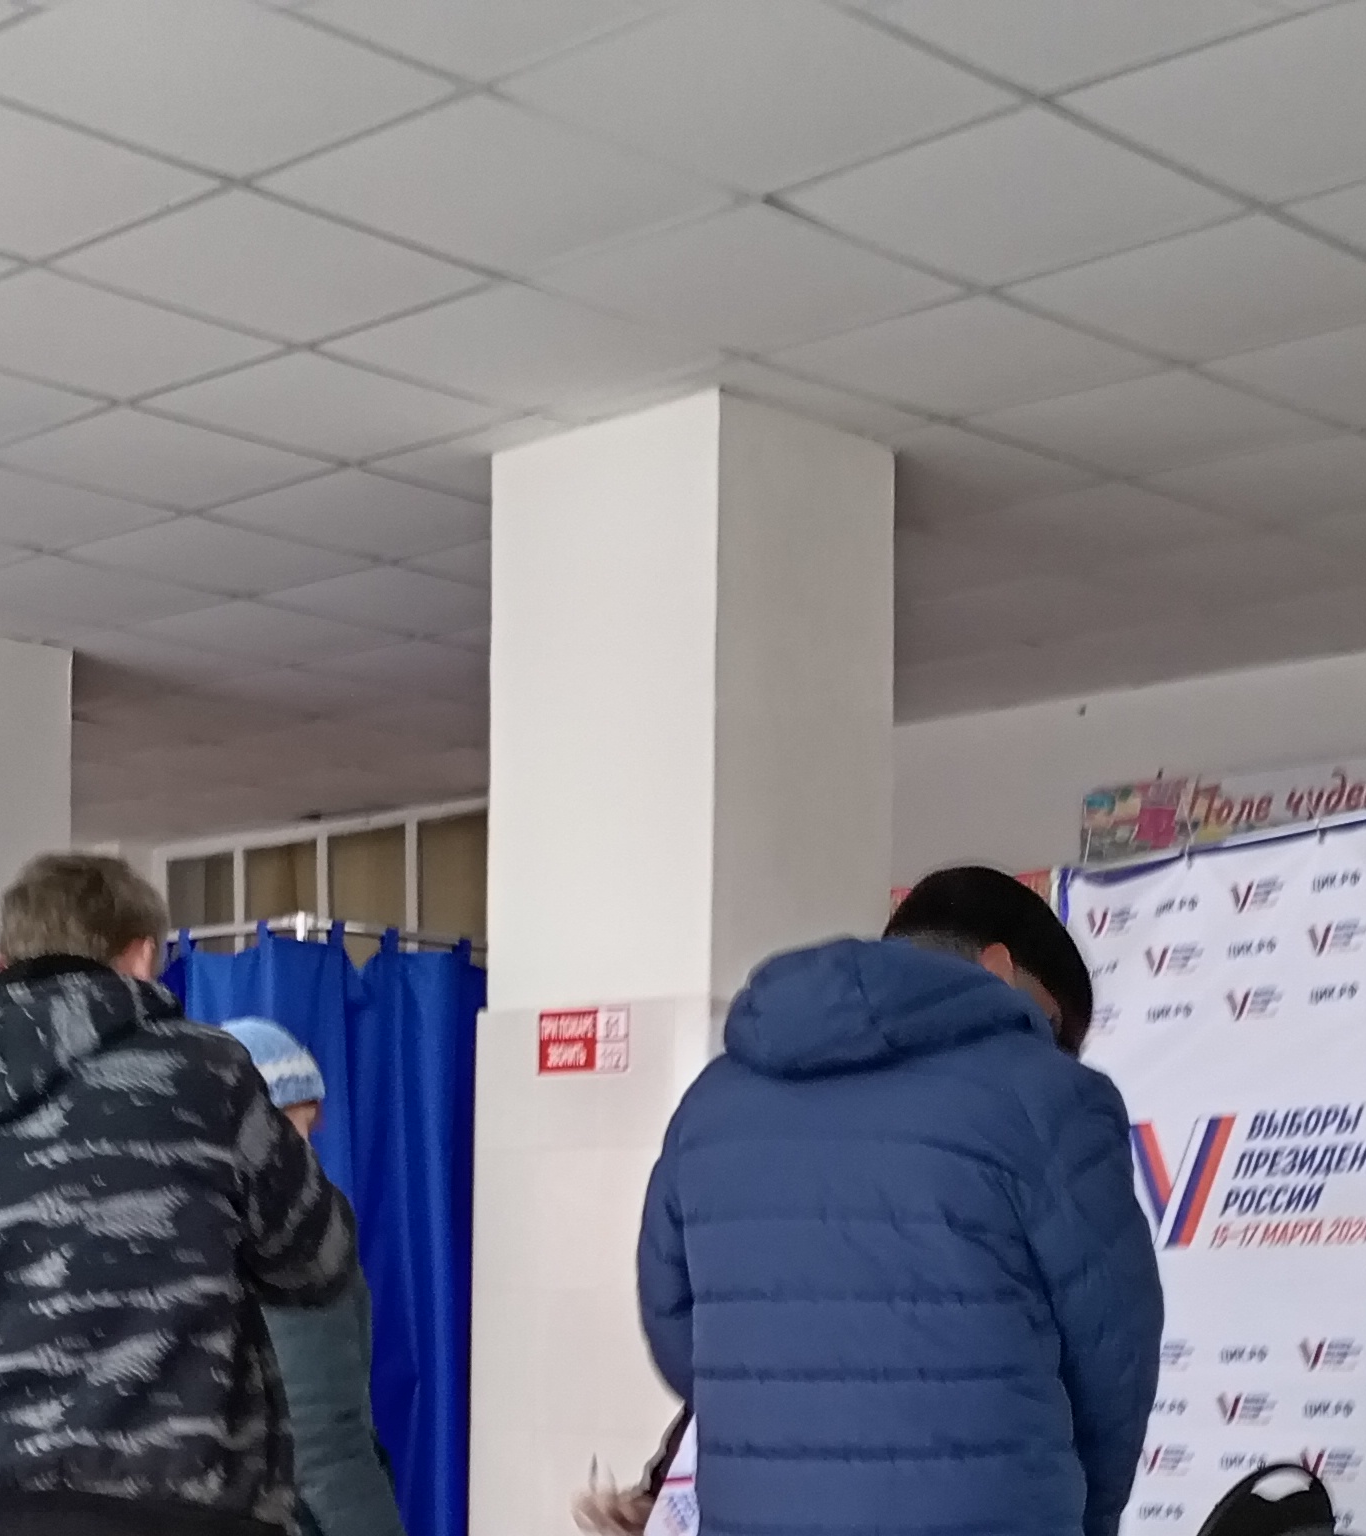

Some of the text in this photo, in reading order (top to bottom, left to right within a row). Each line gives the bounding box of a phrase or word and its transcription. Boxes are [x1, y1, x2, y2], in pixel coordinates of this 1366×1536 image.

[1189, 781, 1274, 828] Поле
[1246, 1102, 1365, 1141] ВЫБОРЫ
[1219, 1181, 1326, 1218] РОССИИ
[1259, 1218, 1325, 1247] МАРТА
